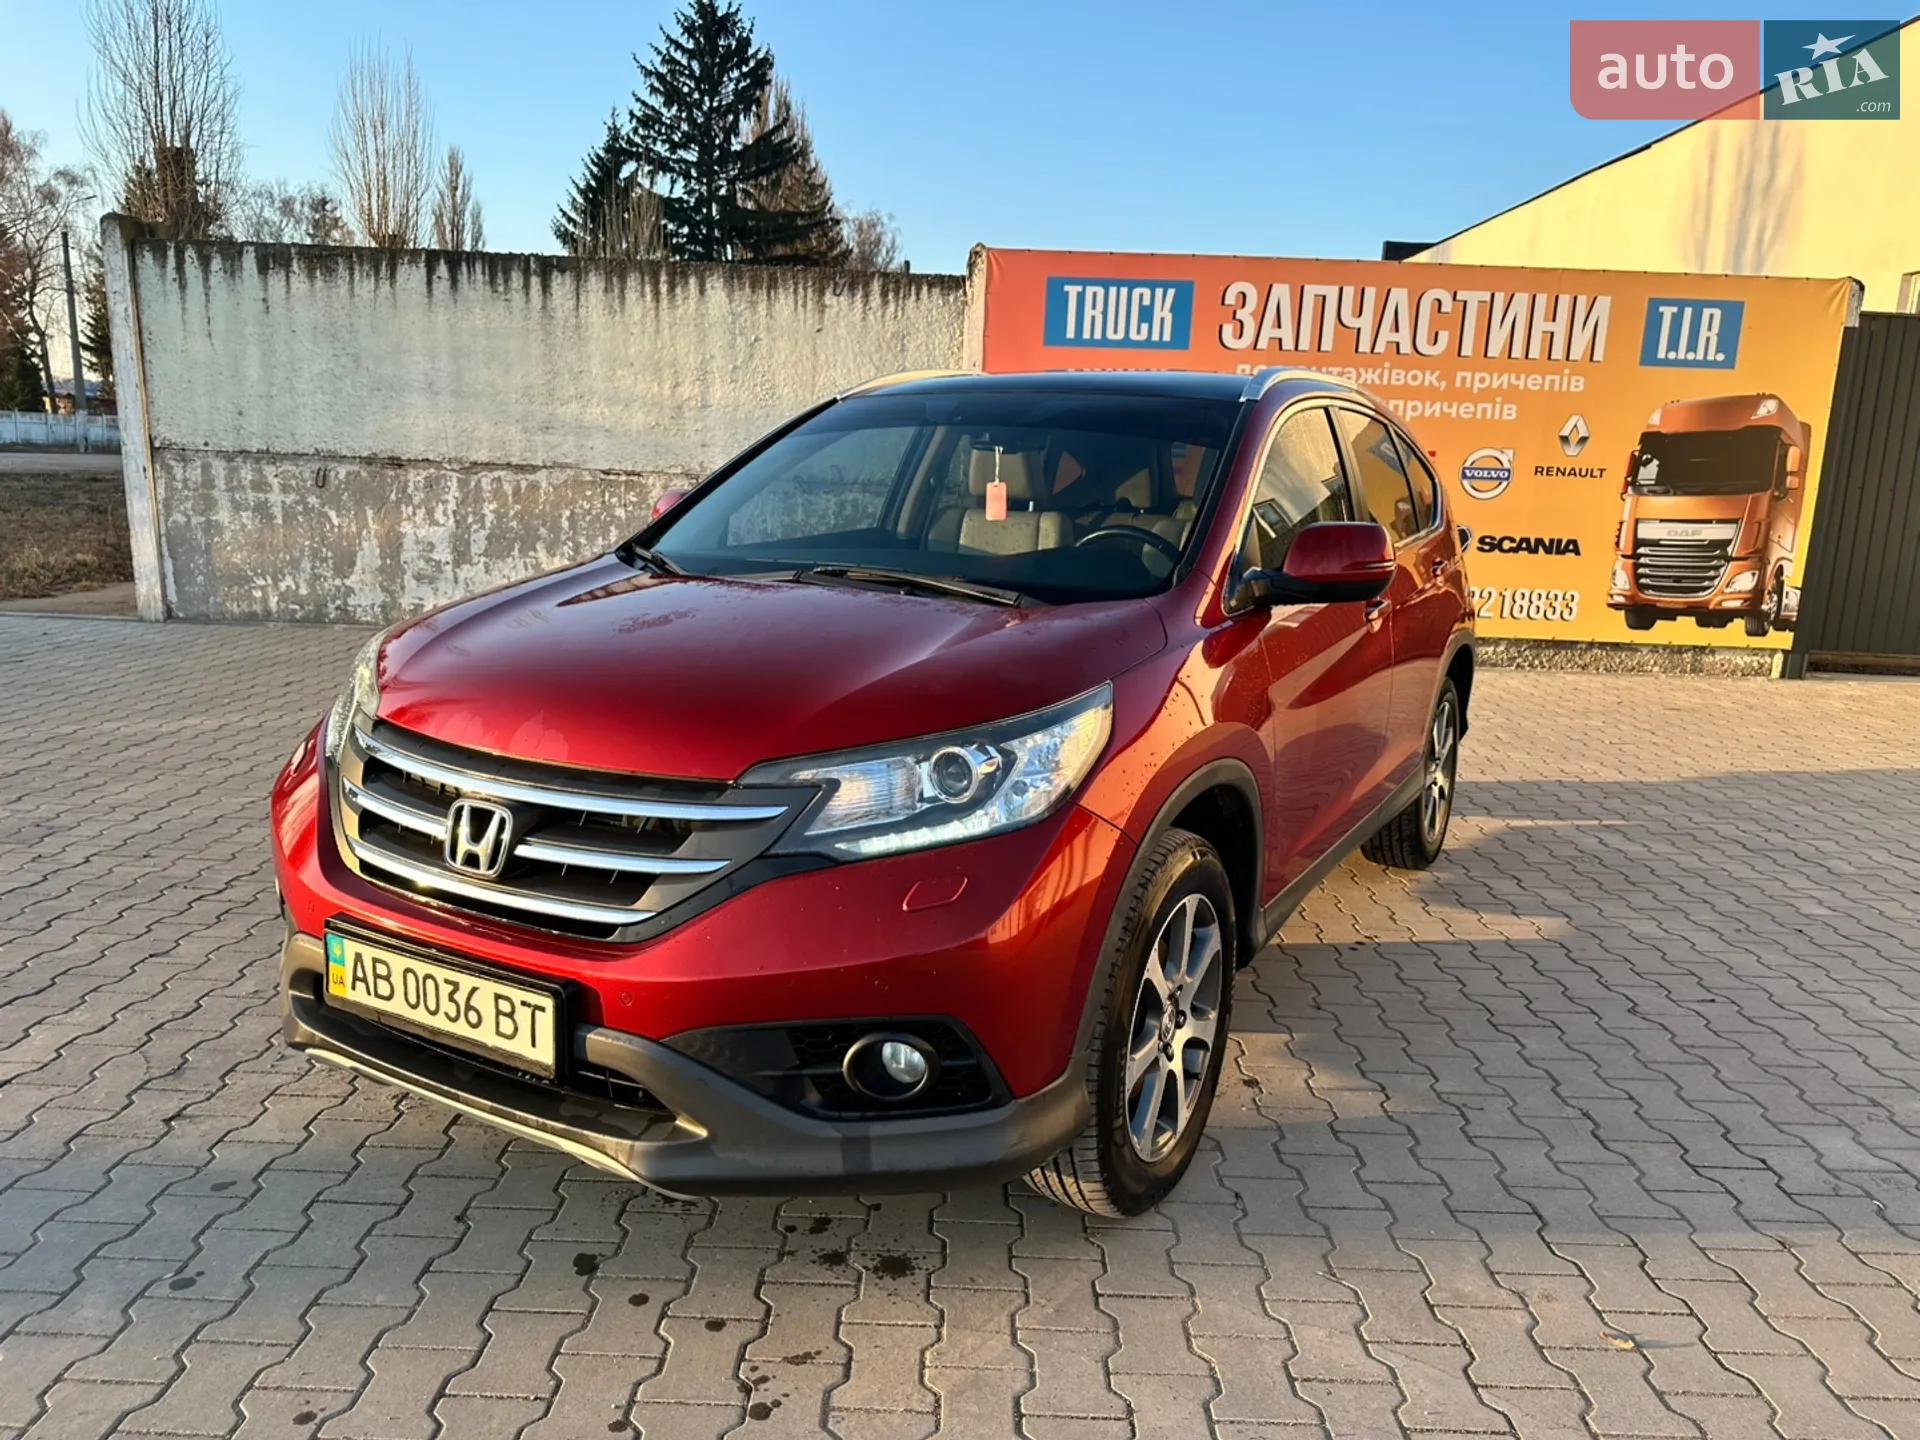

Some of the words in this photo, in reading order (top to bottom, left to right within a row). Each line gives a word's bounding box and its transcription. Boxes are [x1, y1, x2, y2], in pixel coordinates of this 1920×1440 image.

[1063, 285, 1176, 342] TRUCK
[1218, 281, 1611, 362] ЗАПЧАСТИНИ
[1657, 306, 1725, 362] T.I.R.
[1455, 368, 1586, 393] причепів
[1385, 397, 1518, 422] причепів
[1464, 468, 1509, 479] VOLVO
[1533, 465, 1607, 479] RENAULT
[1476, 535, 1582, 556] SCANIA
[1666, 529, 1703, 537] DAF
[332, 973, 346, 988] UA
[351, 951, 395, 1001] AB
[402, 967, 482, 1029] 0036
[494, 992, 546, 1048] BT
